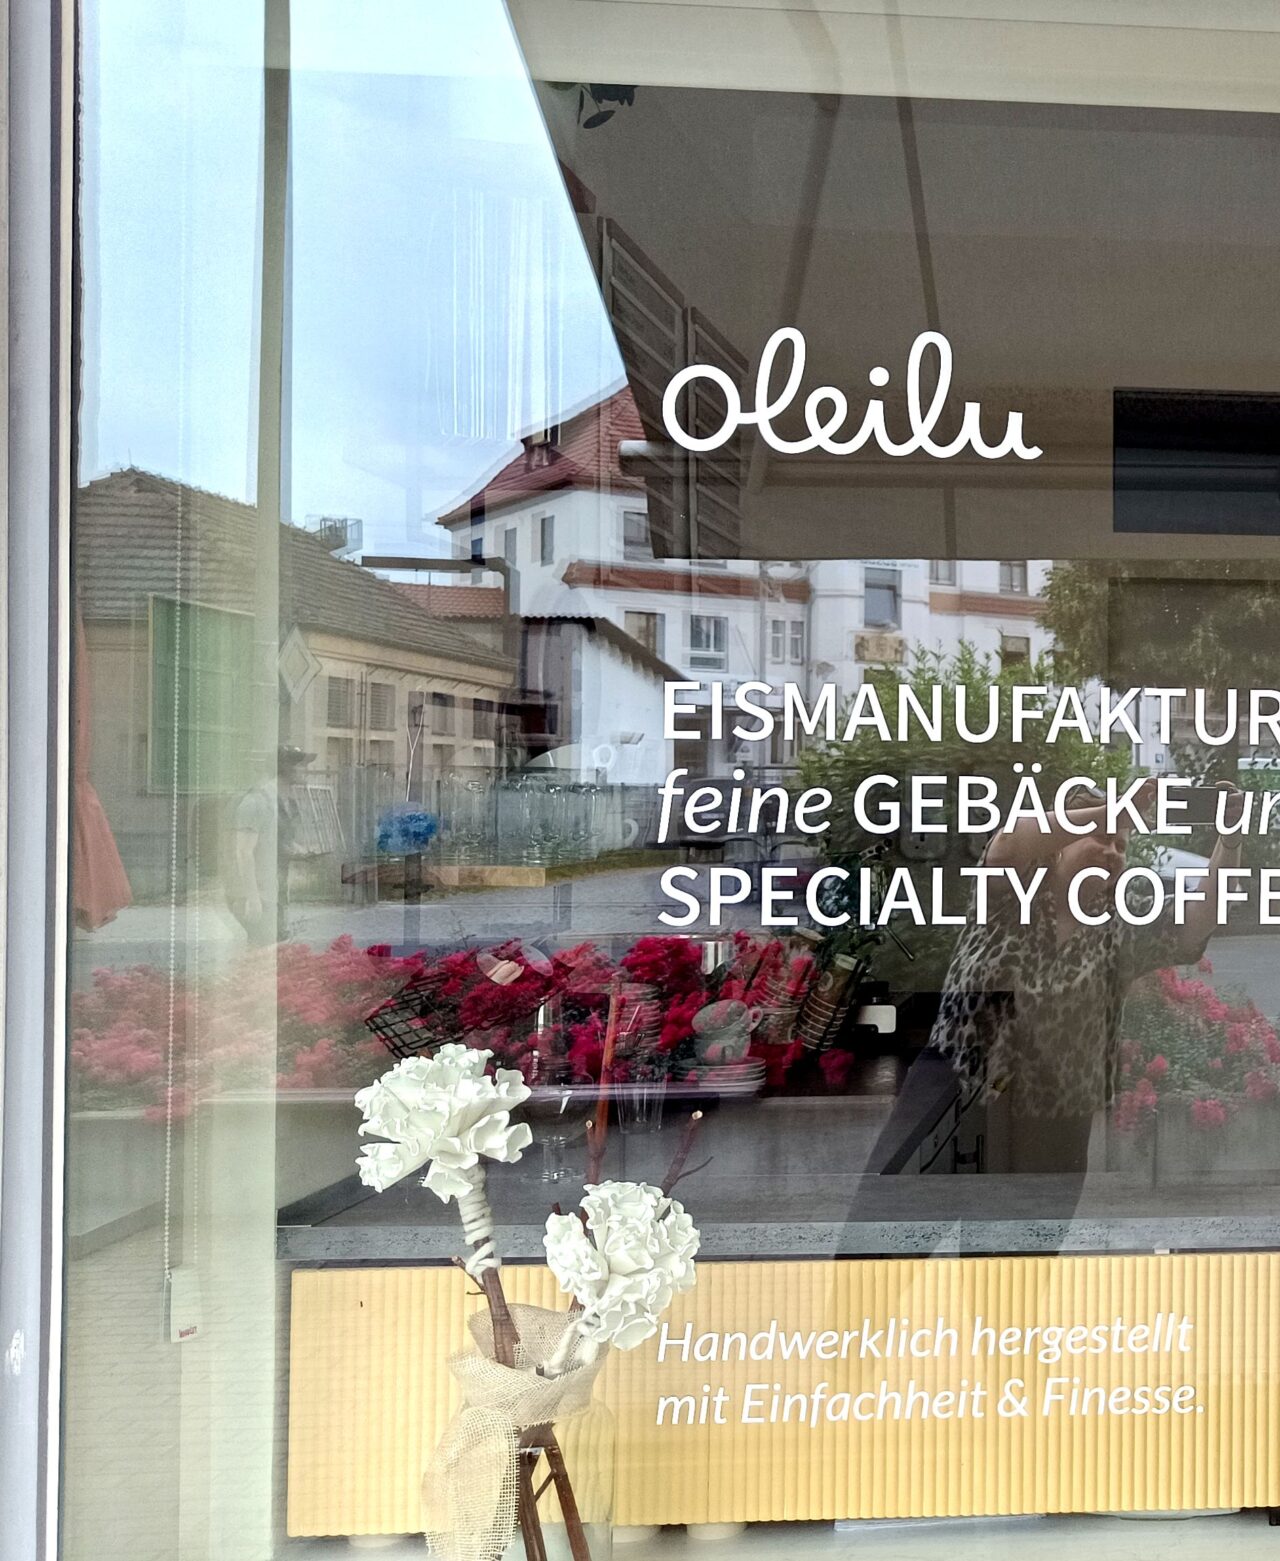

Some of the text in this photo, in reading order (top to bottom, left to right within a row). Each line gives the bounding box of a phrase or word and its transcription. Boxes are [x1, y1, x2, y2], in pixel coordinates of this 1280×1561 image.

[657, 768, 833, 843] feine
[853, 762, 1193, 835] GEBÄCKE
[657, 866, 1048, 927] SPECIALTY
[657, 1312, 1194, 1364] Handwerklich hergestellt
[656, 1376, 1206, 1428] mit Einfachheit & Finesse.
